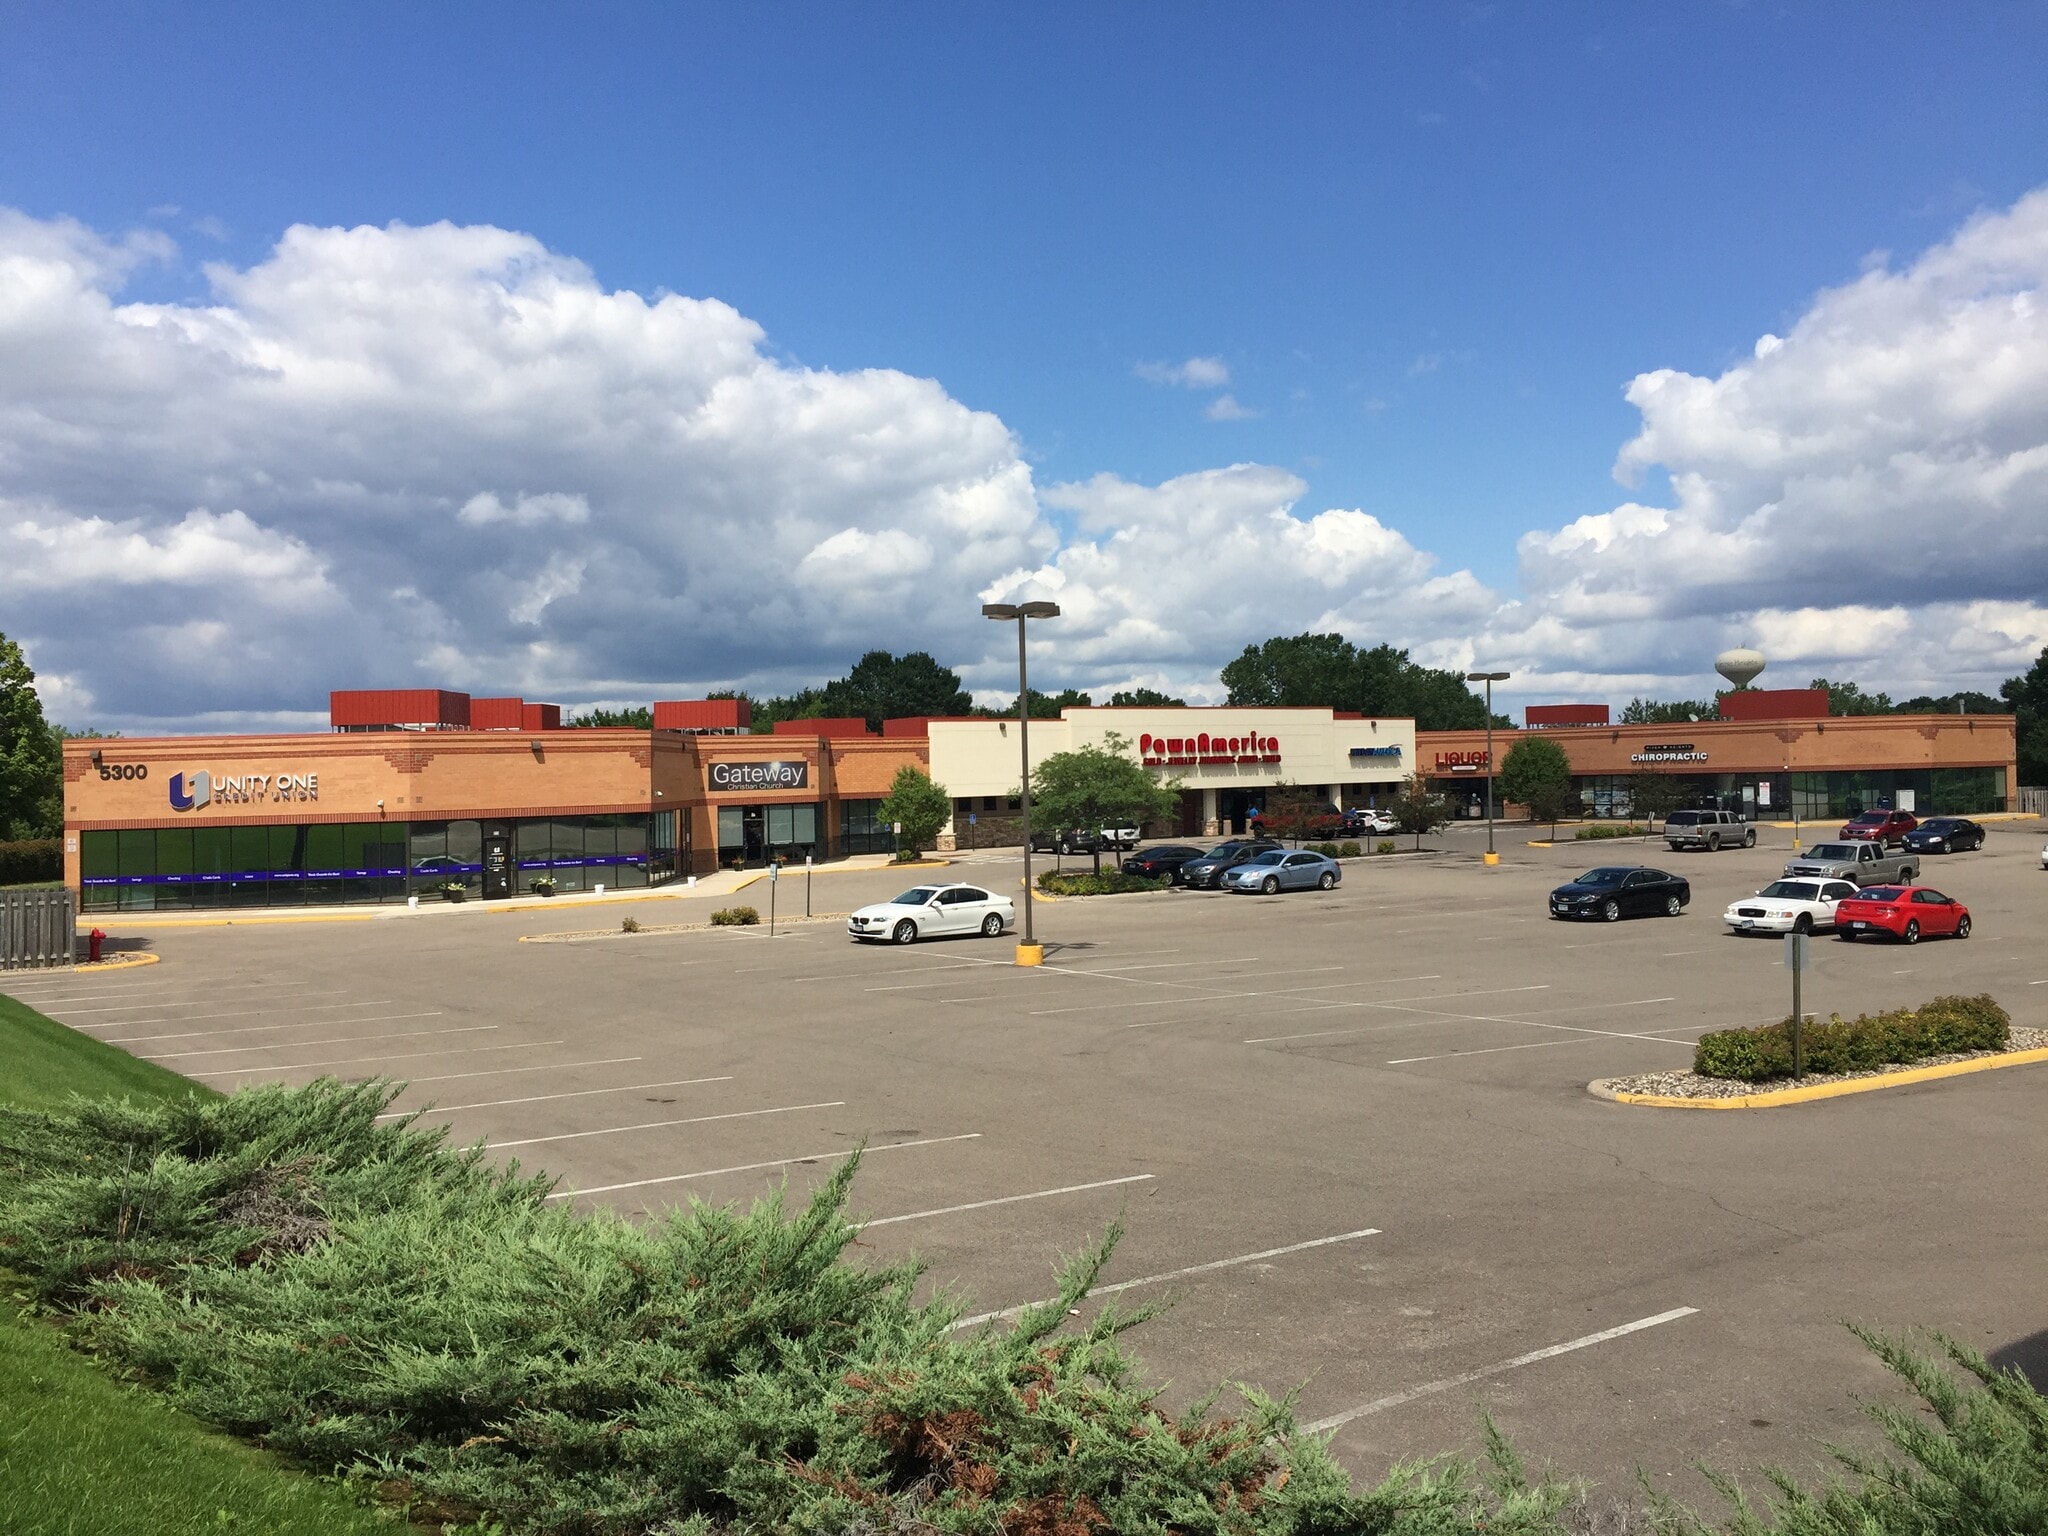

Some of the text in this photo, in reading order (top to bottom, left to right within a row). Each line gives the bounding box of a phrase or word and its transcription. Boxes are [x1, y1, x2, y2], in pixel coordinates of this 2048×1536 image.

[1140, 730, 1279, 754] PawnAmerica
[1631, 752, 1708, 762] CHIROPRACTIC
[100, 764, 147, 781] 5300
[714, 763, 803, 786] Gateway
[212, 773, 318, 791] UNITY ONE
[727, 782, 784, 791] Christian Church
[213, 790, 318, 802] CREDIT UNION
